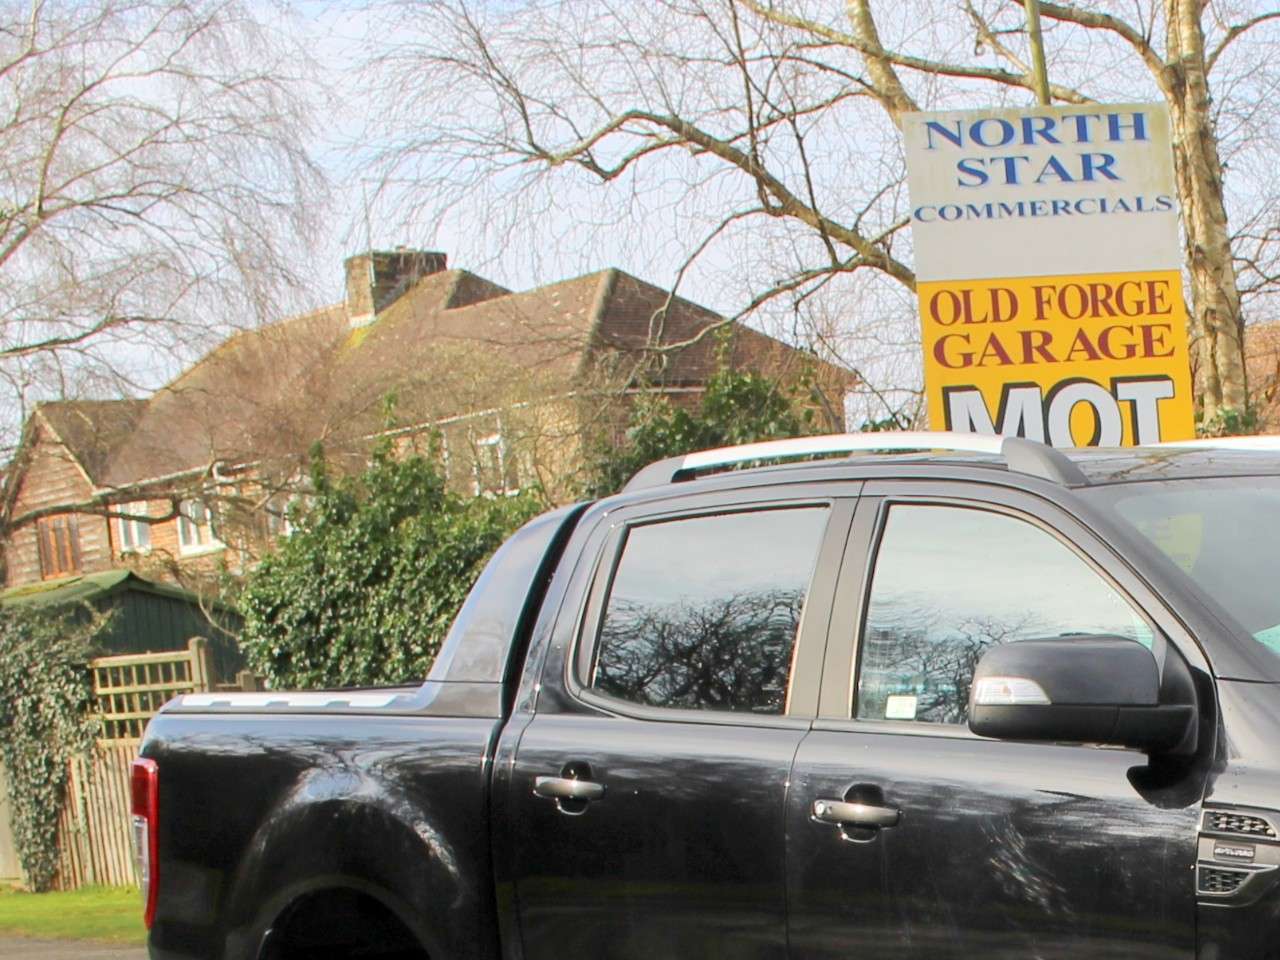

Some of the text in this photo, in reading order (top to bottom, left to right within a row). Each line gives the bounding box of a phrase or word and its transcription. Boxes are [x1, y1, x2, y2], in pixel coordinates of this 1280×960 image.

[925, 112, 1151, 150] NORTH
[957, 153, 1123, 188] STAR
[914, 195, 1174, 224] COMMERCIALS
[929, 280, 1173, 327] OLD FORGE
[932, 323, 1176, 369] GARAGE
[942, 374, 1176, 449] MOT
